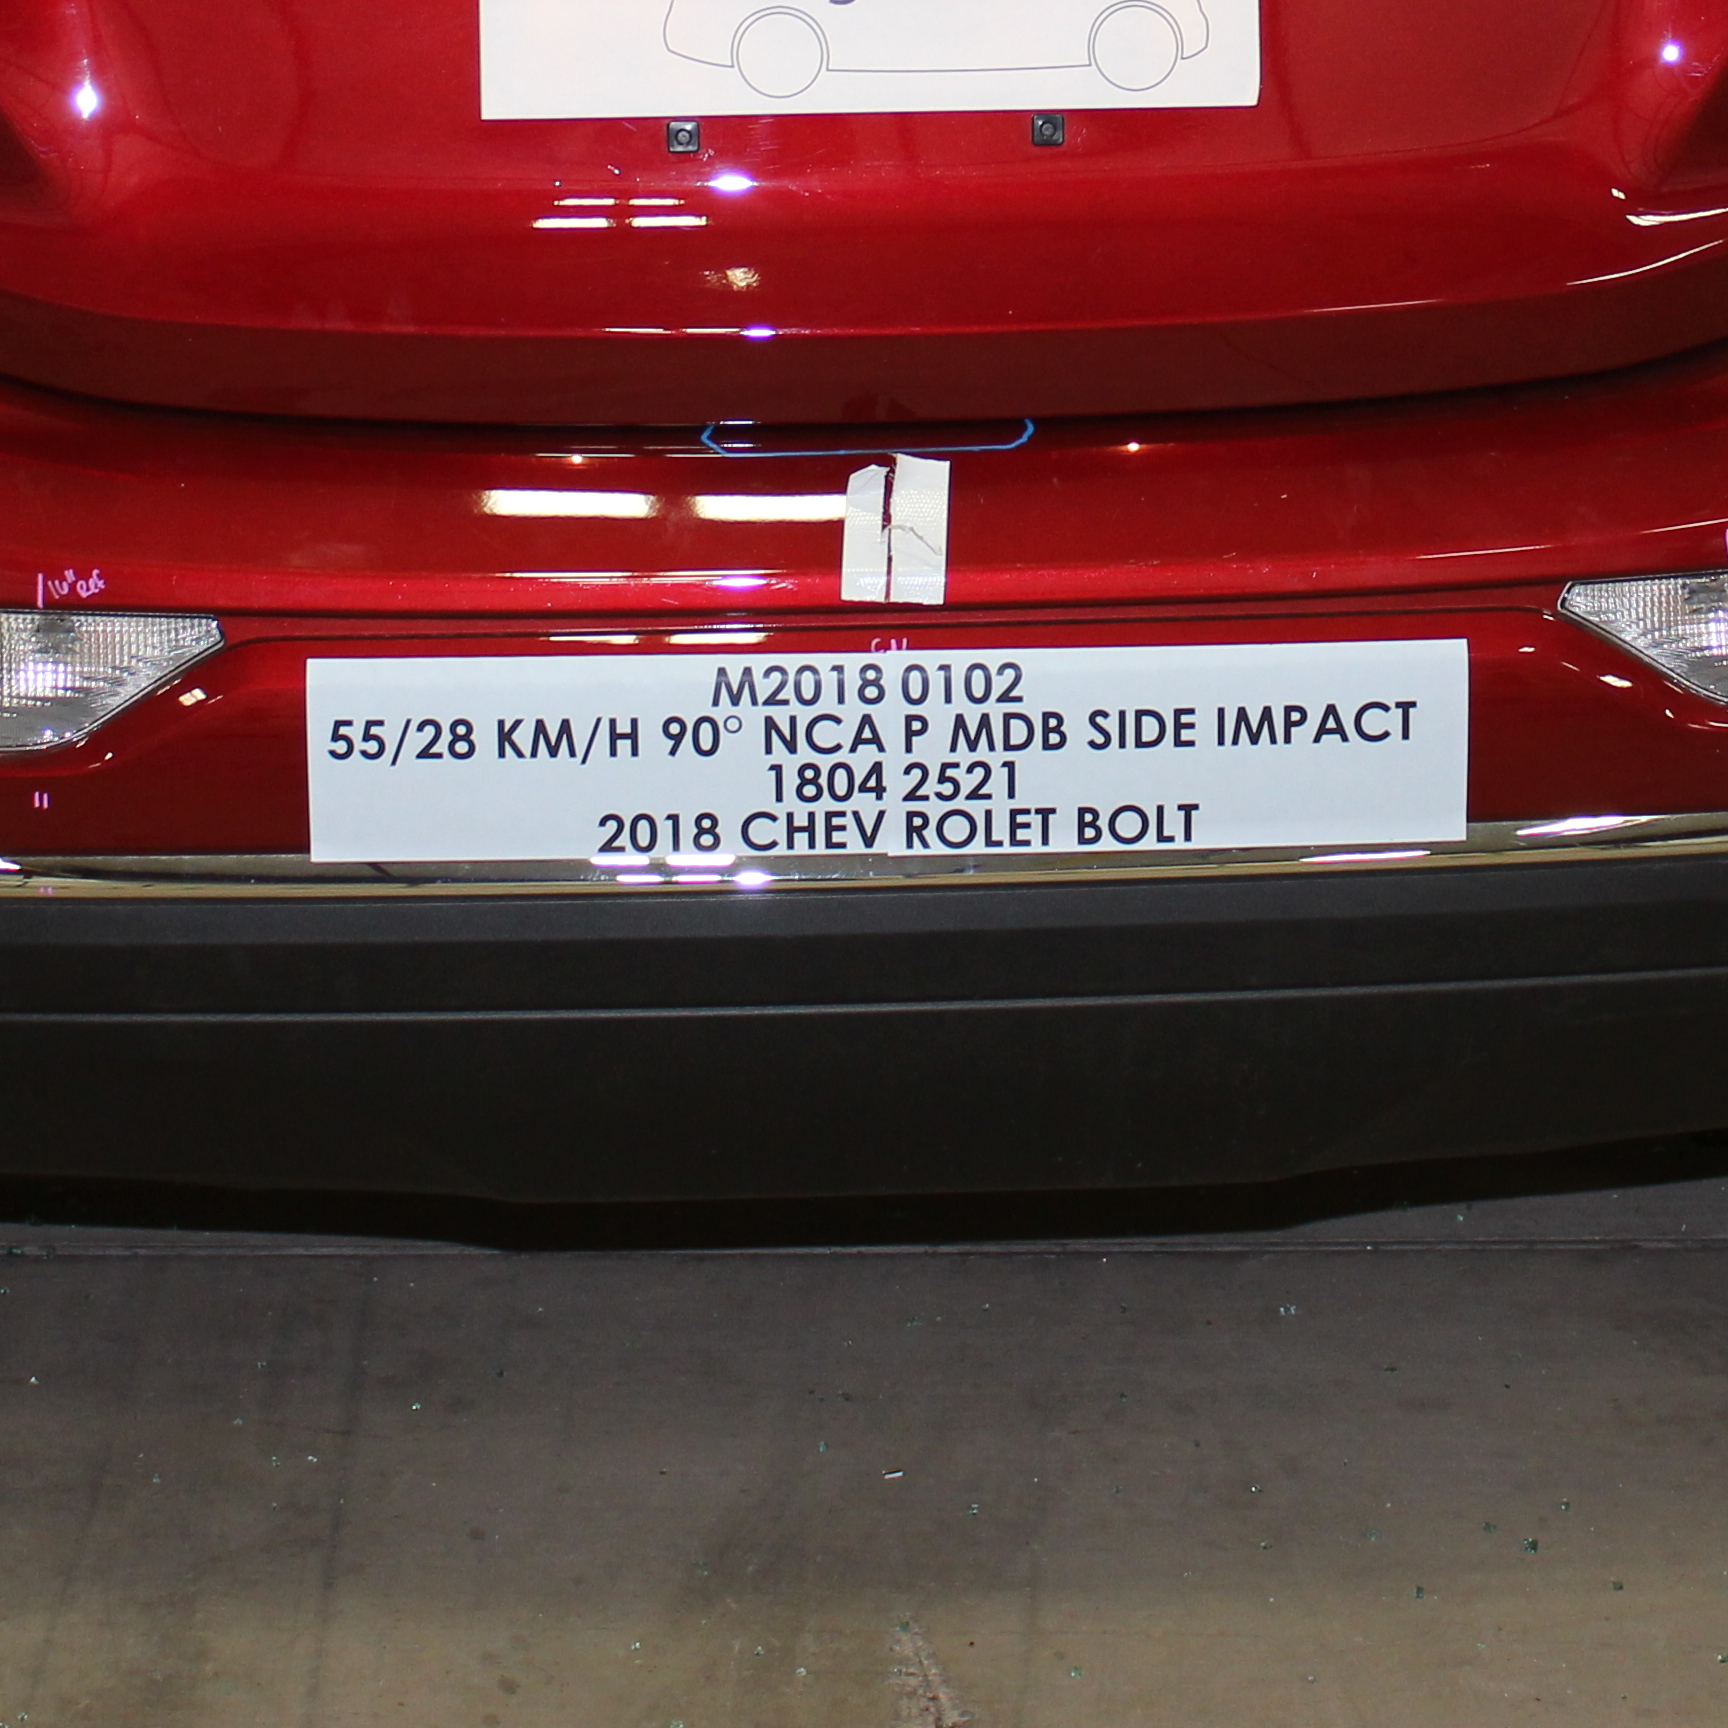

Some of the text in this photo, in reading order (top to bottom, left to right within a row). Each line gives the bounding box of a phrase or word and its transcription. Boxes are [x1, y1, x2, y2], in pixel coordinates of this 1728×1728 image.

[327, 717, 478, 767] 55/28
[497, 716, 640, 766] KM/H
[661, 714, 744, 758] 90°
[949, 709, 1069, 754] MDB
[1086, 706, 1197, 752] SIDE
[1217, 700, 1419, 748] IMPACT
[597, 811, 722, 855] 2018
[1077, 802, 1201, 847] BOLT
